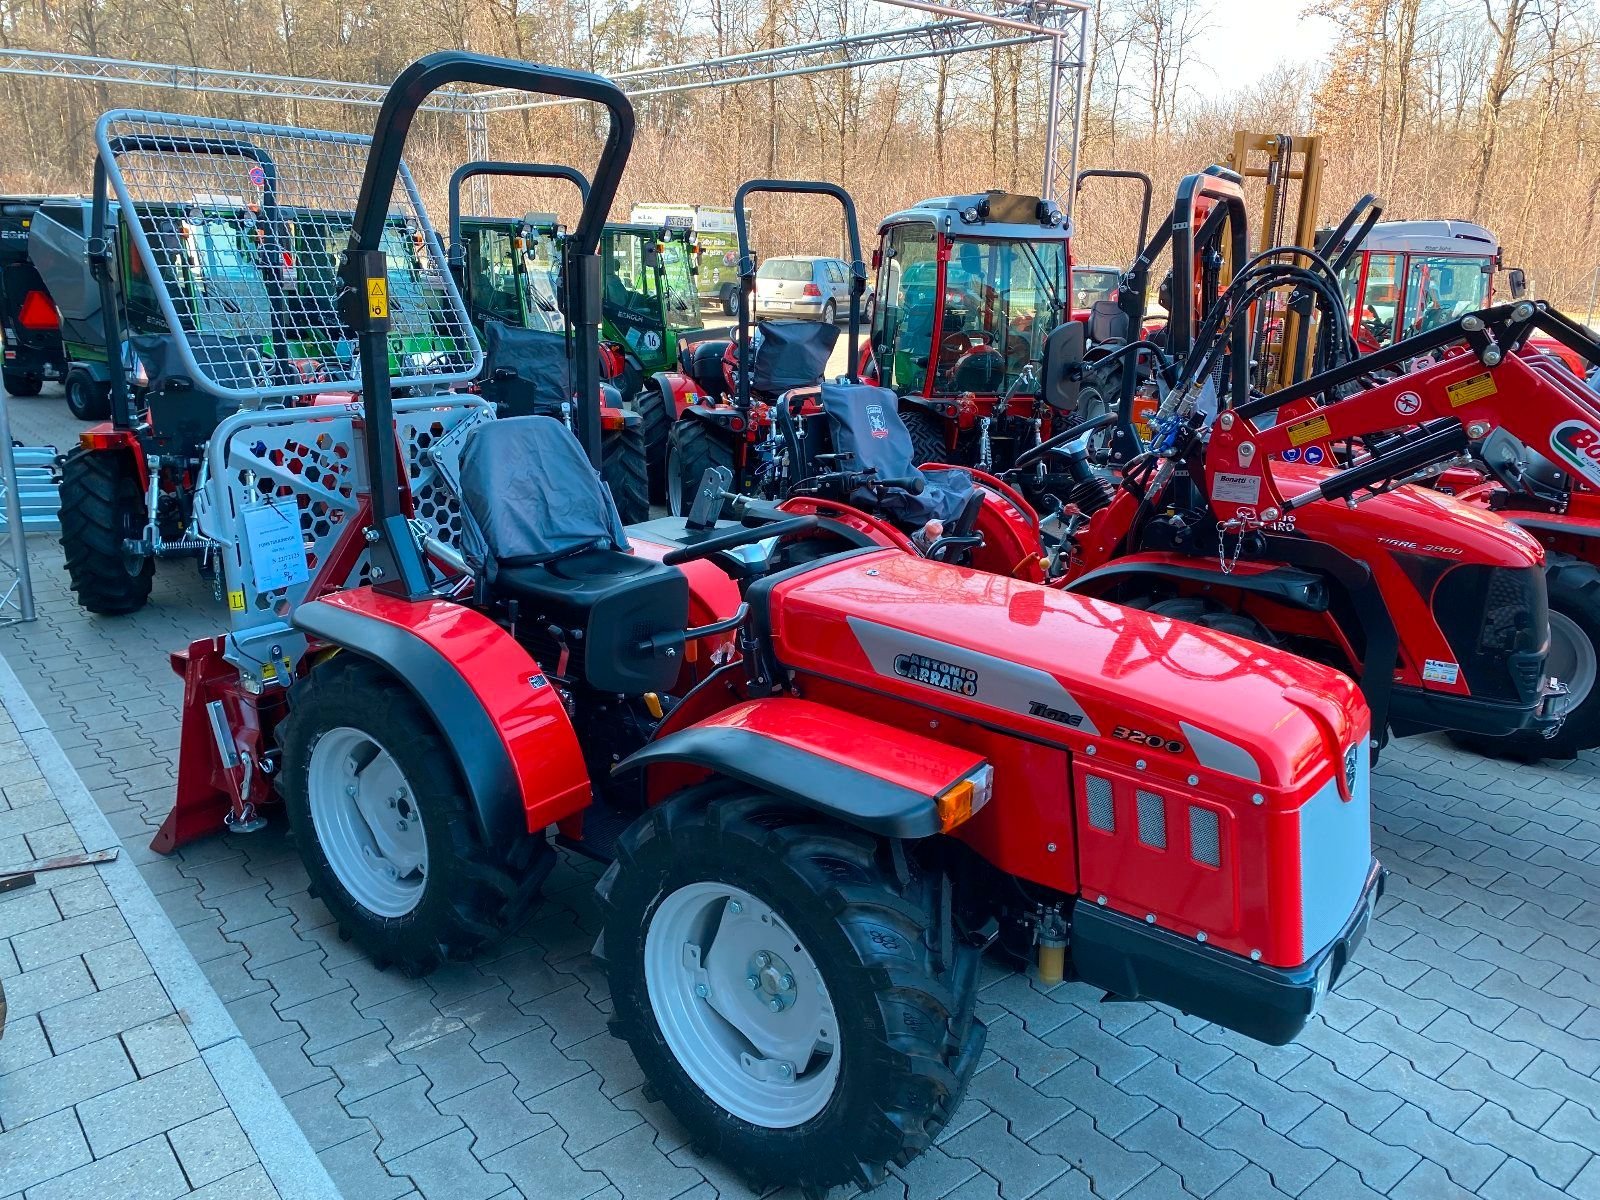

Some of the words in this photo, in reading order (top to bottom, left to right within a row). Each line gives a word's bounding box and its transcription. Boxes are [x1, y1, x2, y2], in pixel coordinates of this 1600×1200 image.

[647, 334, 657, 347] 16
[1220, 475, 1247, 485] Bonatti
[1377, 537, 1417, 549] TIGRE
[893, 653, 978, 697] CARRARO
[910, 653, 978, 681] ANTONIO
[1112, 724, 1185, 753] 3200
